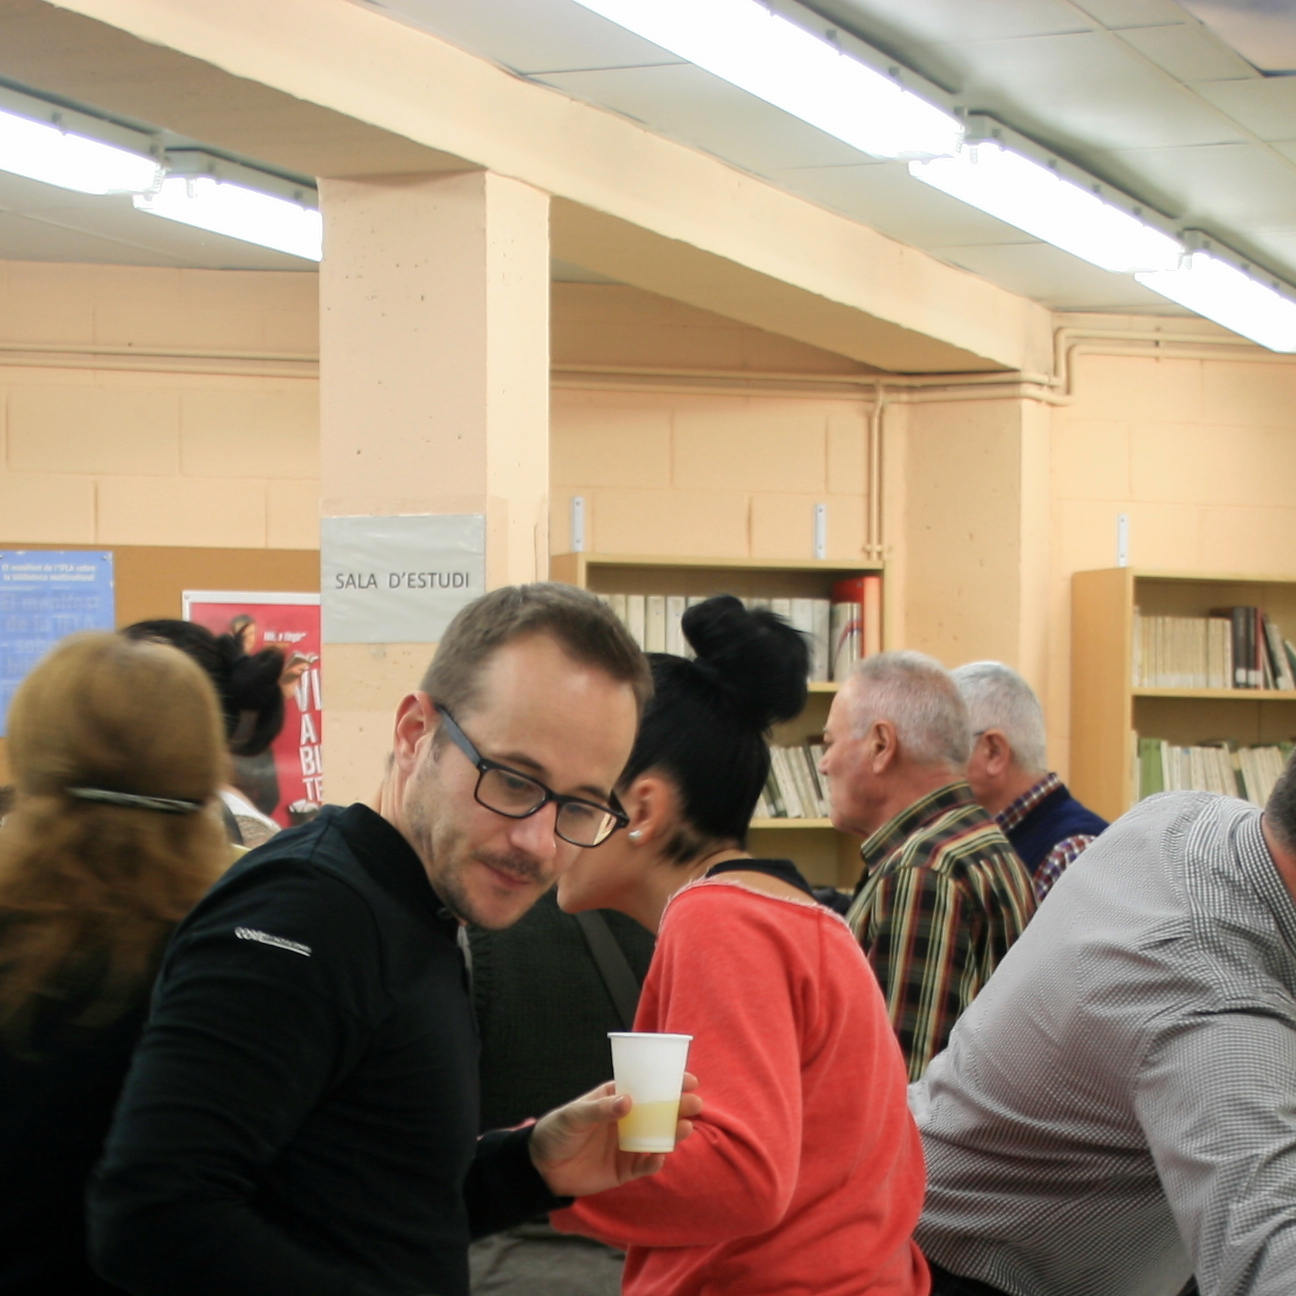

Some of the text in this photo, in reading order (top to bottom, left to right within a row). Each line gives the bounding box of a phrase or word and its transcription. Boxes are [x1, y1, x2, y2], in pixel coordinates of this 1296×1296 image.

[335, 571, 469, 589] SALA D'ESTUDI
[300, 713, 317, 746] A
